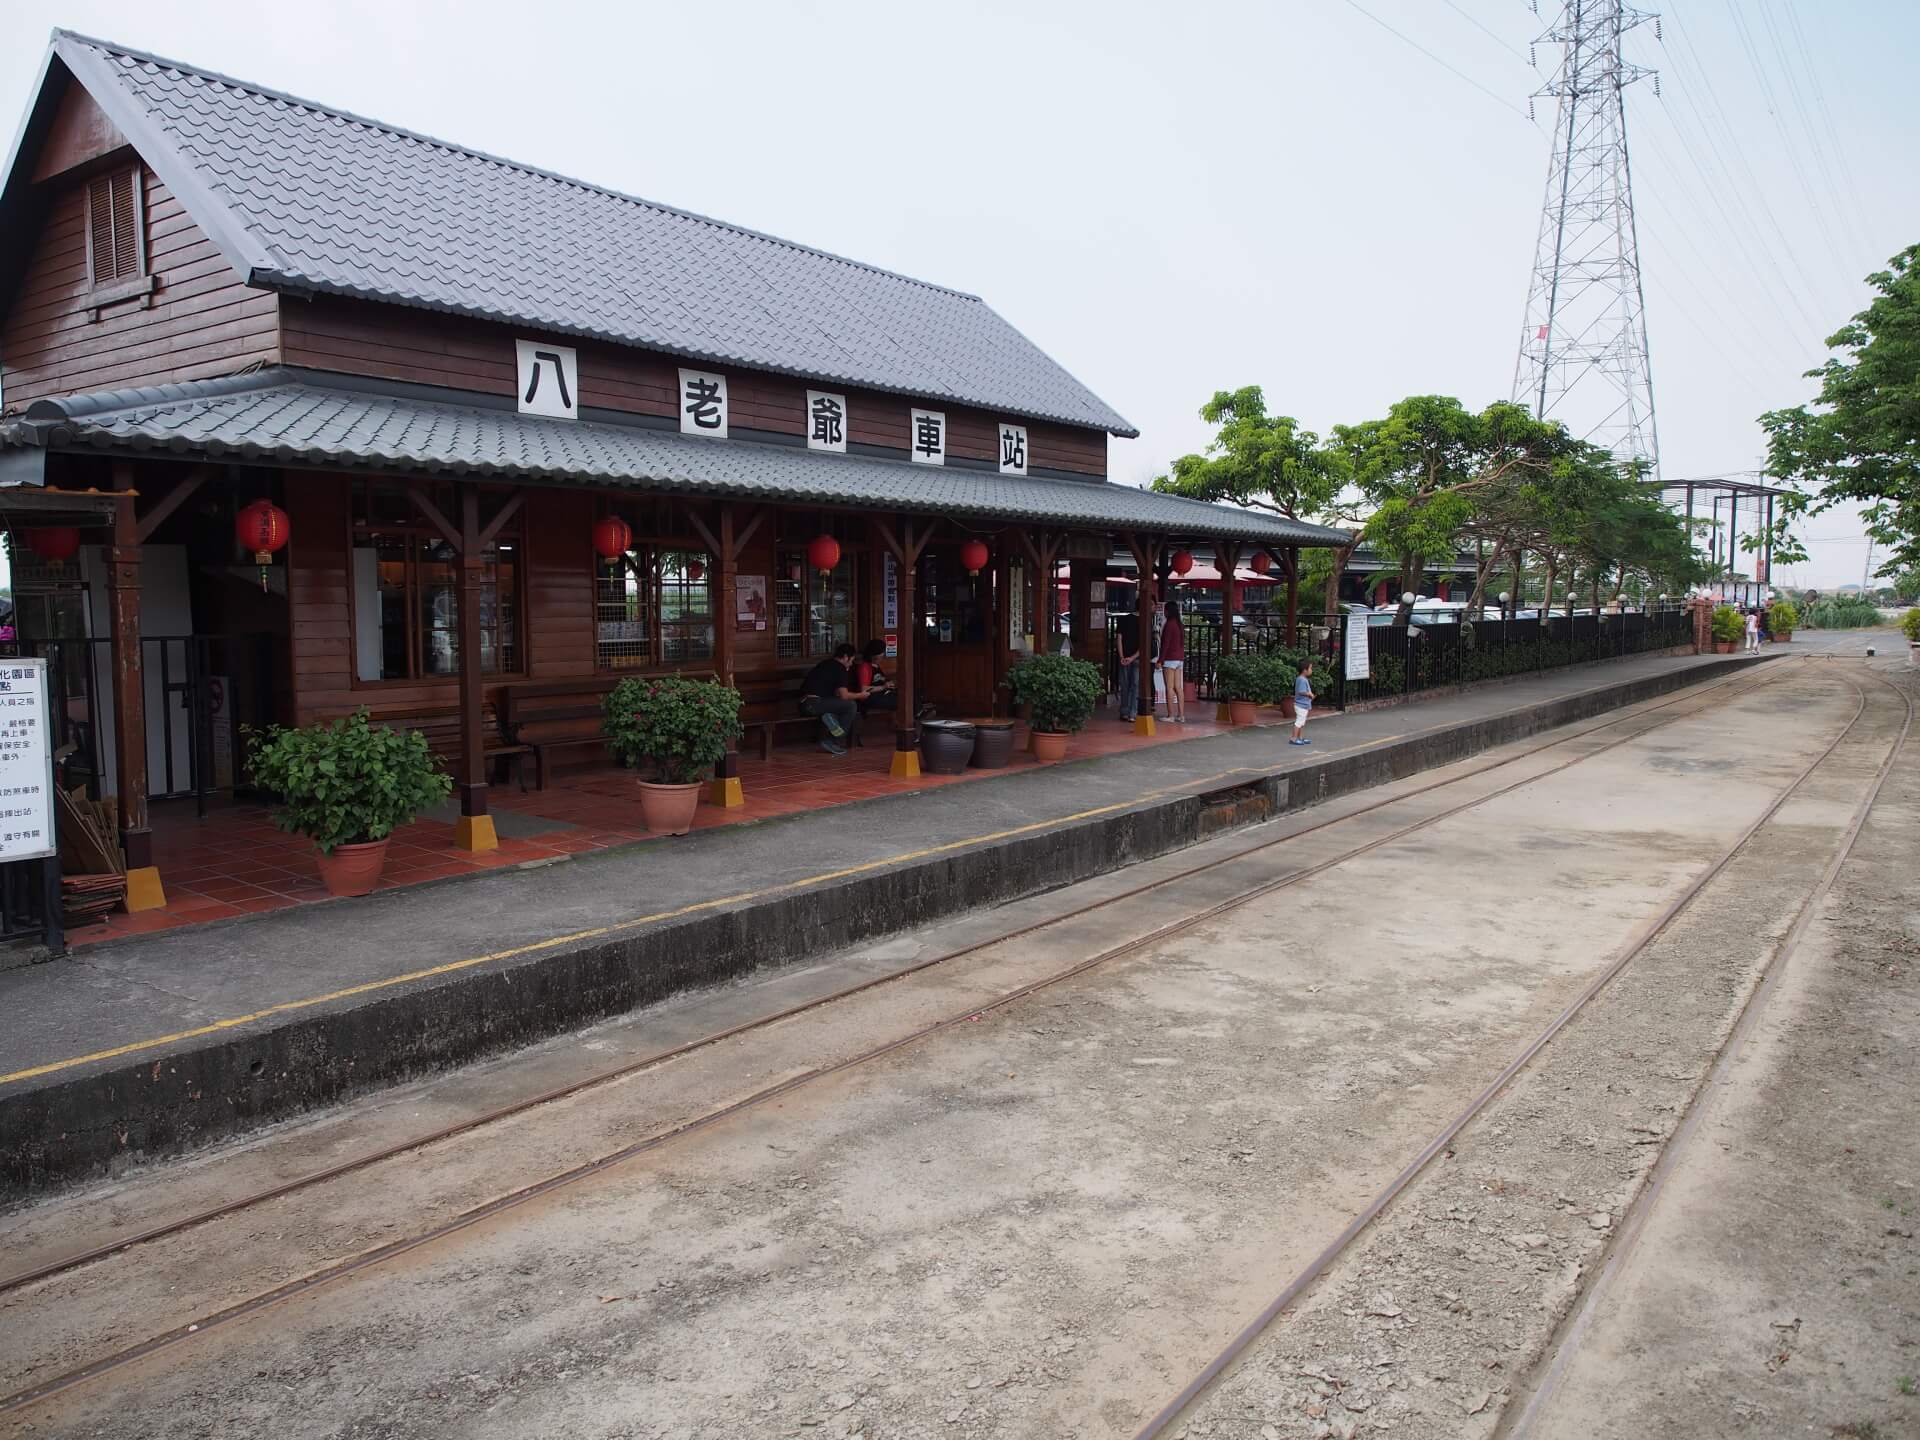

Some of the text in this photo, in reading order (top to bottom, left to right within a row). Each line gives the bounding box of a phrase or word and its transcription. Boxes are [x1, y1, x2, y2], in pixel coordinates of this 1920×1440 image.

[525, 351, 1025, 469] 八老爺車站
[0, 668, 36, 679] 化園區
